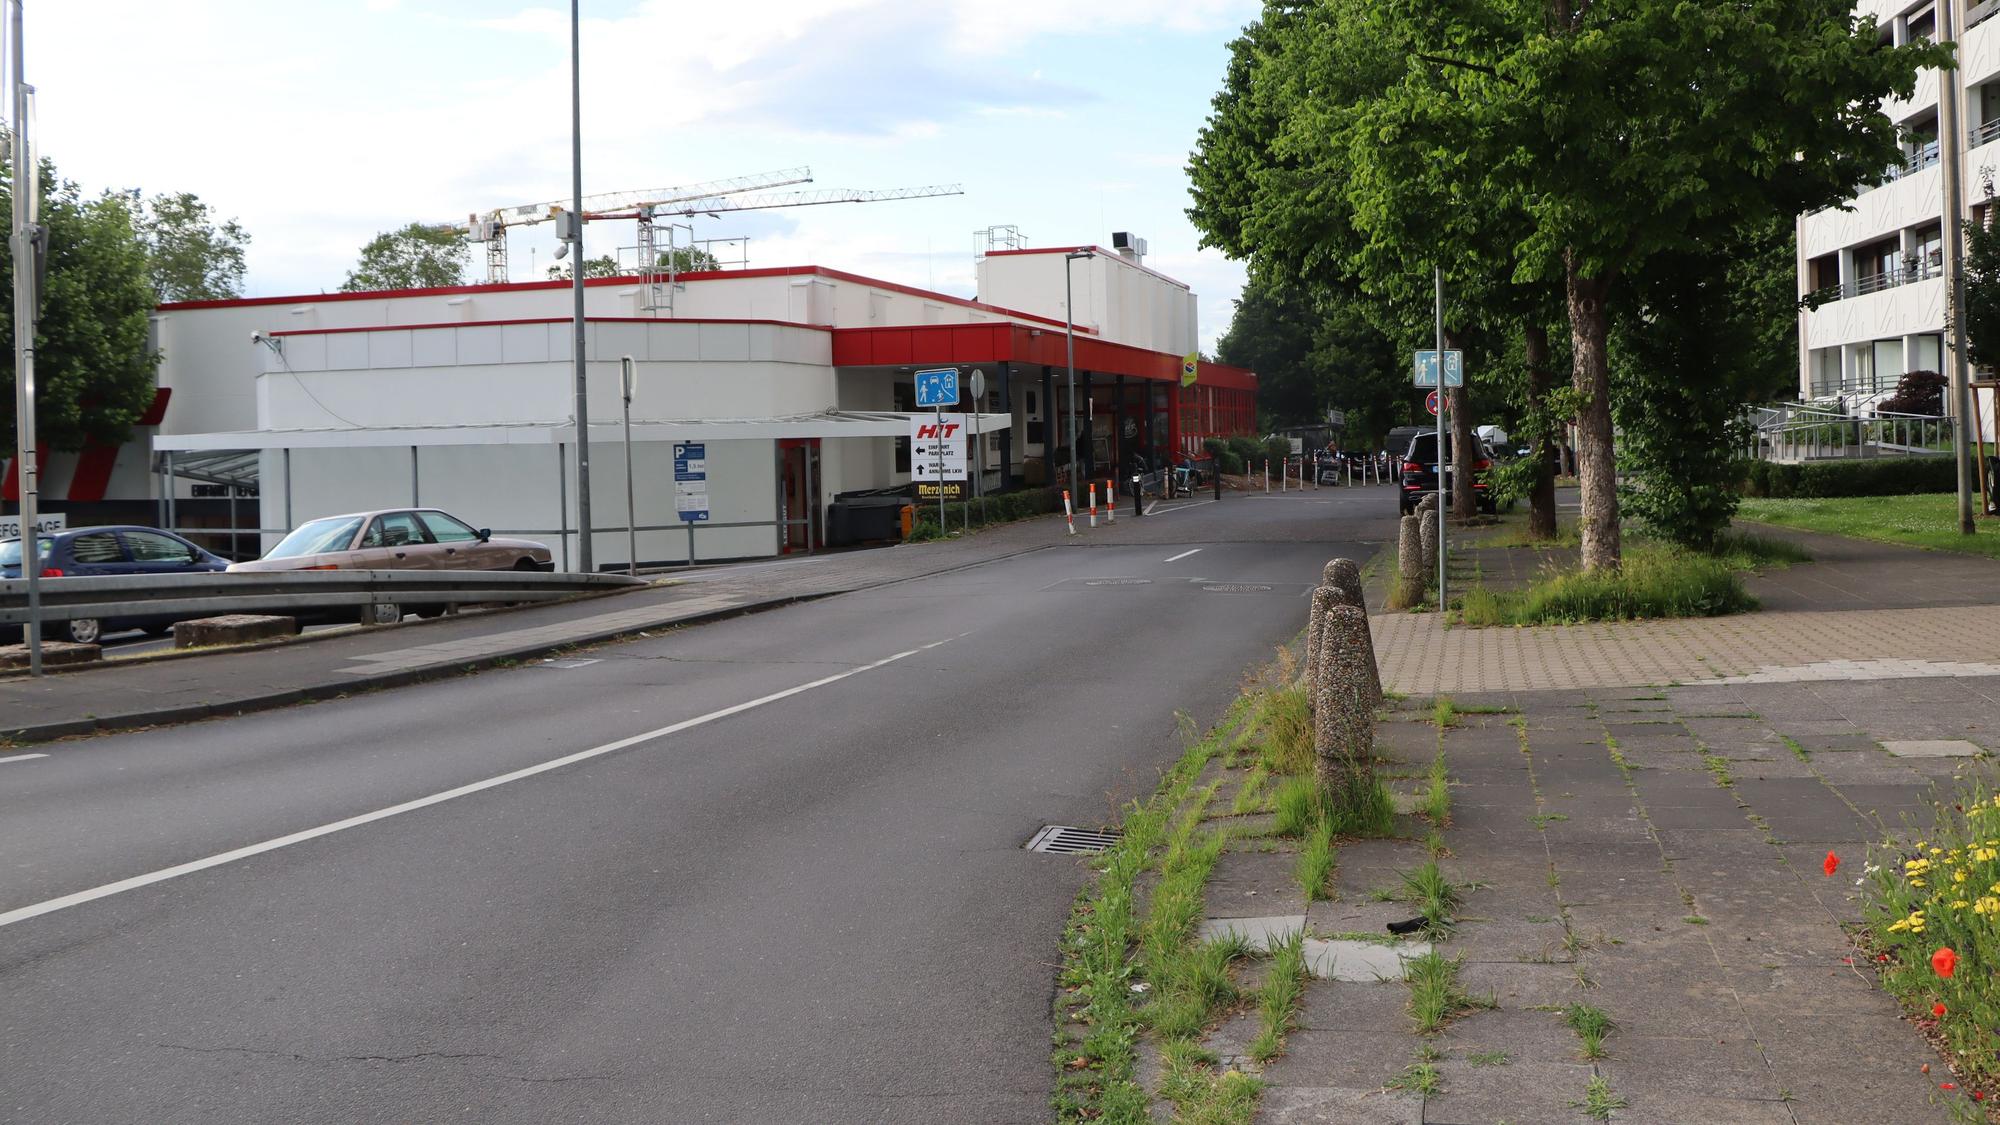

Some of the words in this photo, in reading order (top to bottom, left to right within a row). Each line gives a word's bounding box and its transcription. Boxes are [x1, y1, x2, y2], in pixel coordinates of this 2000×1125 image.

[917, 424, 959, 438] HIT
[676, 446, 685, 459] P
[918, 484, 960, 494] Merznich
[0, 521, 61, 537] FGAGE
